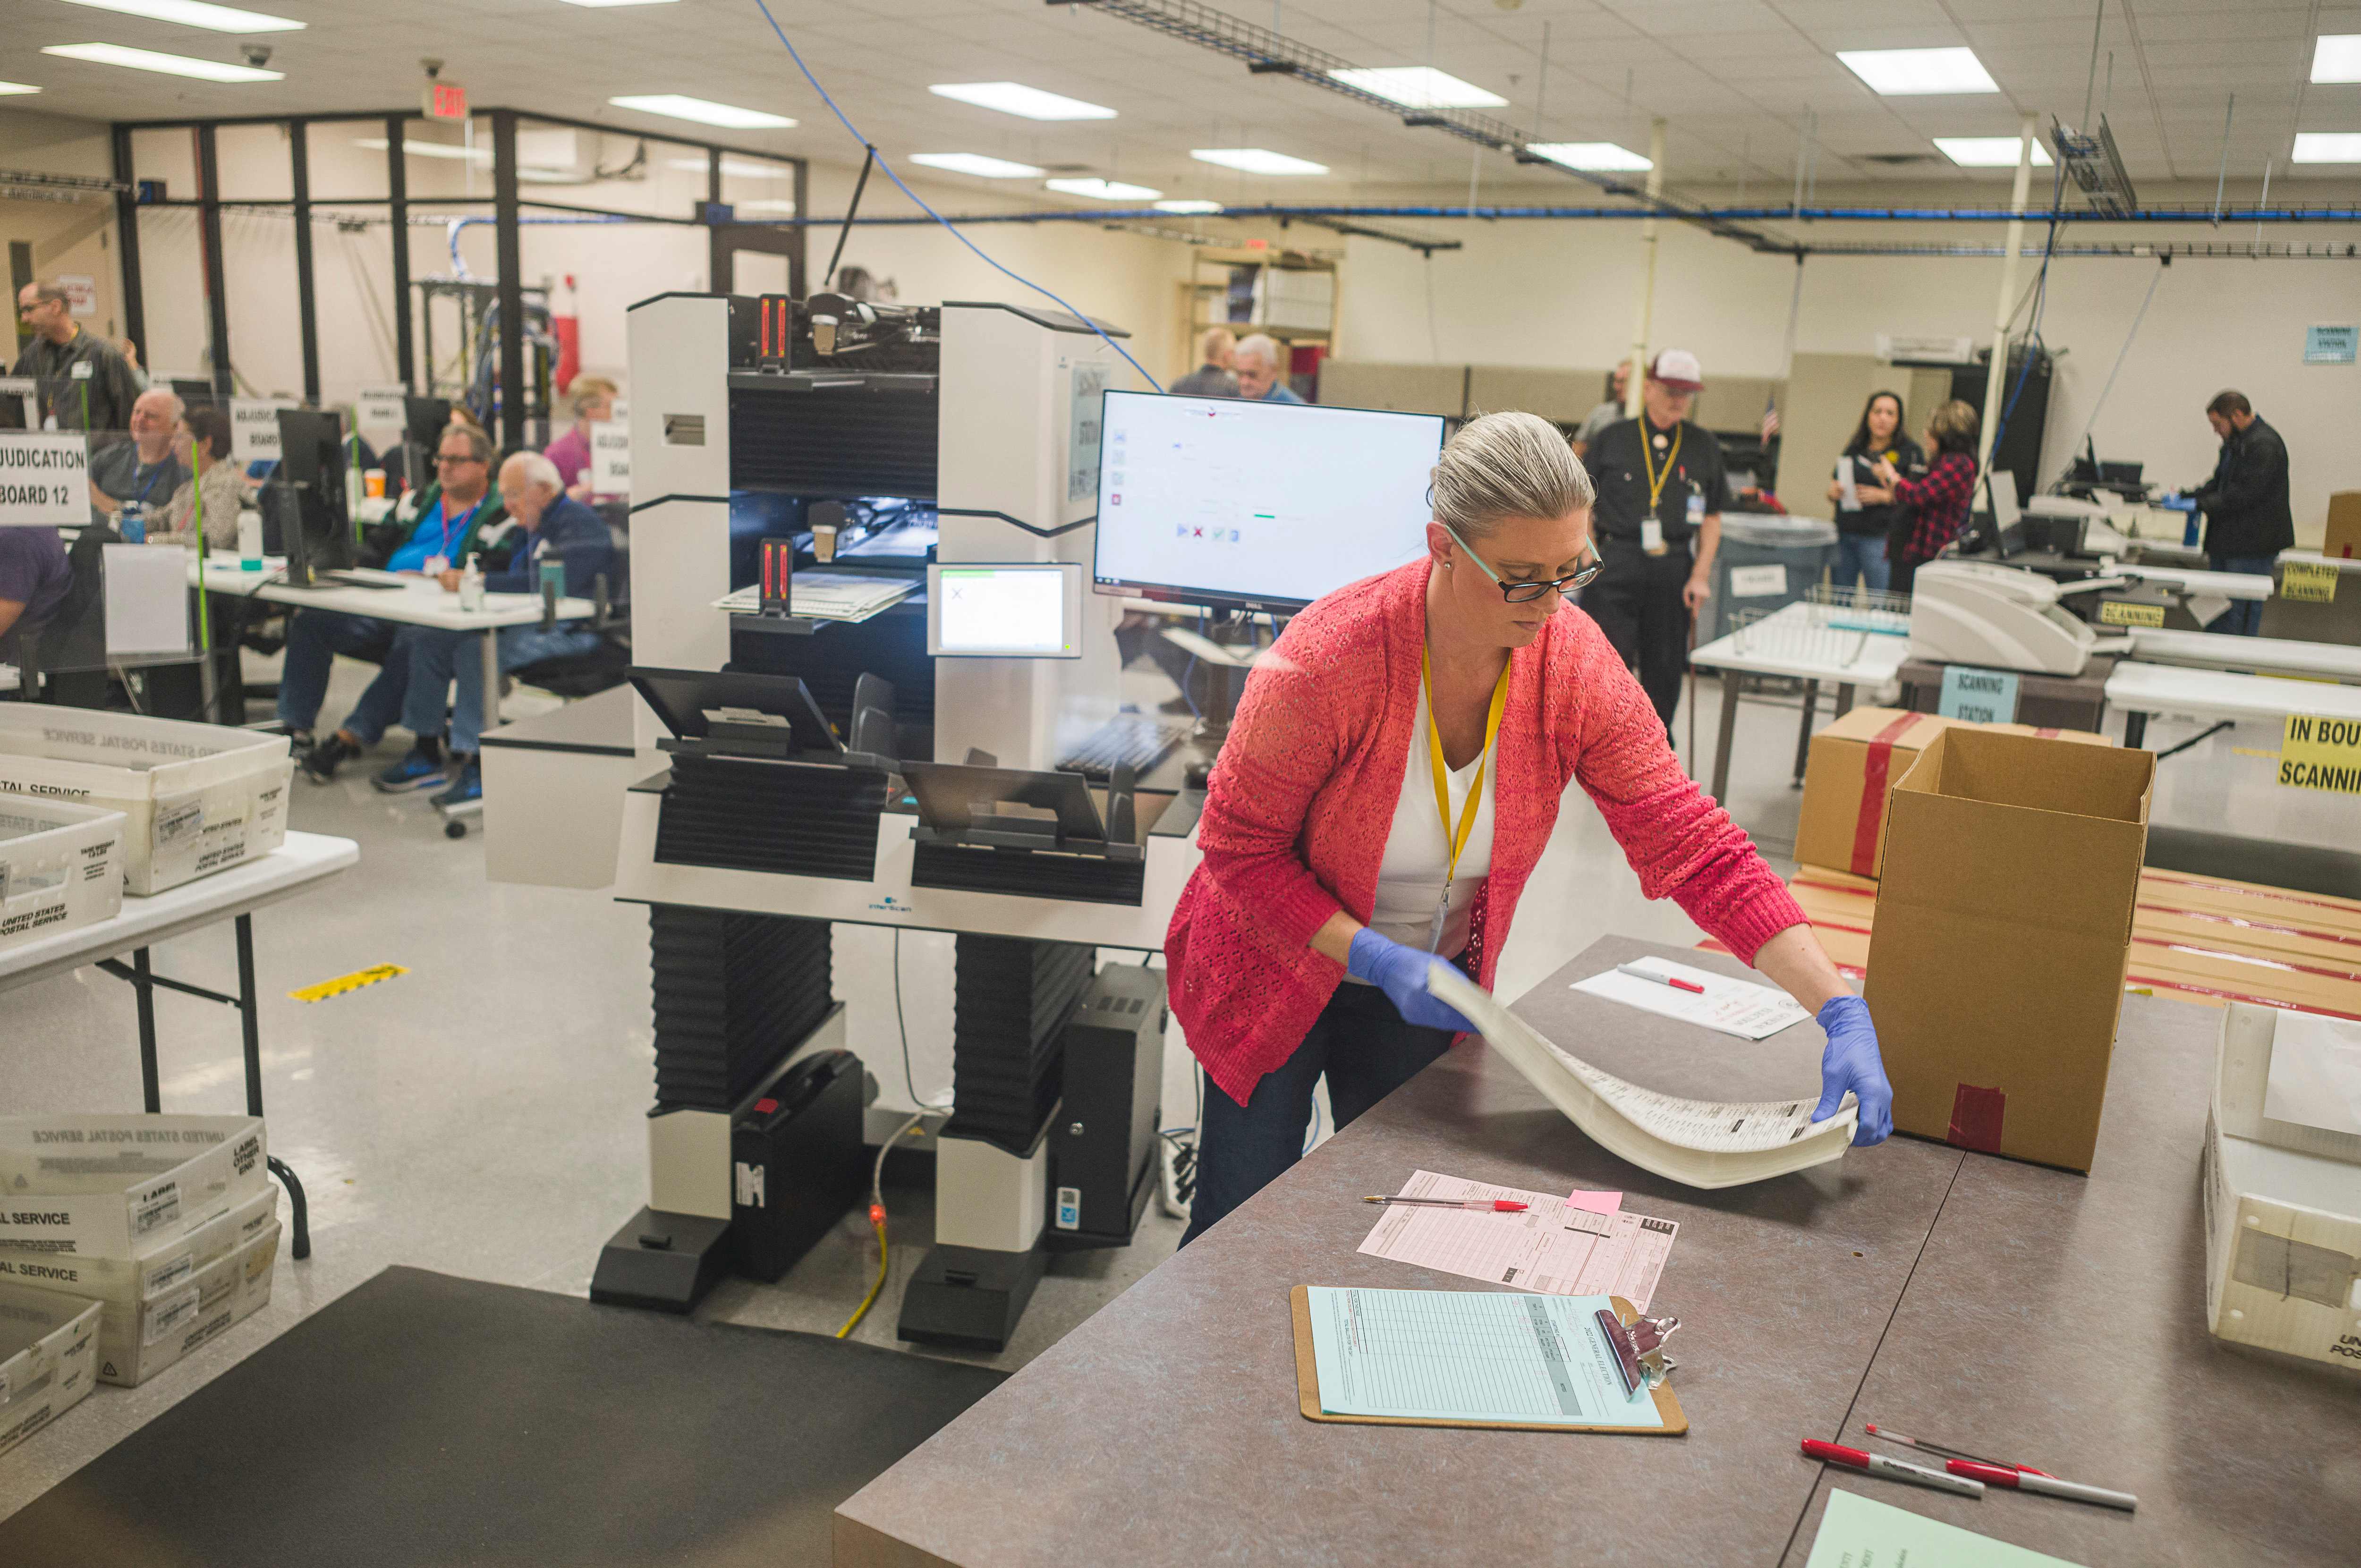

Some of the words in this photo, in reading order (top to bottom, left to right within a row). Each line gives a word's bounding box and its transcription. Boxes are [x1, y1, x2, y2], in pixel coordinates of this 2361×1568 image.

[52, 485, 68, 506] 12
[1958, 673, 2003, 695] SCANNING
[2291, 718, 2312, 741] IN
[2, 913, 34, 927] UNITED
[34, 902, 65, 917] STATES
[32, 911, 68, 929] SERVICE
[12, 1212, 70, 1225] SERVICE
[19, 1263, 78, 1282] SERVICE
[1588, 1337, 1603, 1360] GENERAL
[1597, 1360, 1613, 1385] ELECTION
